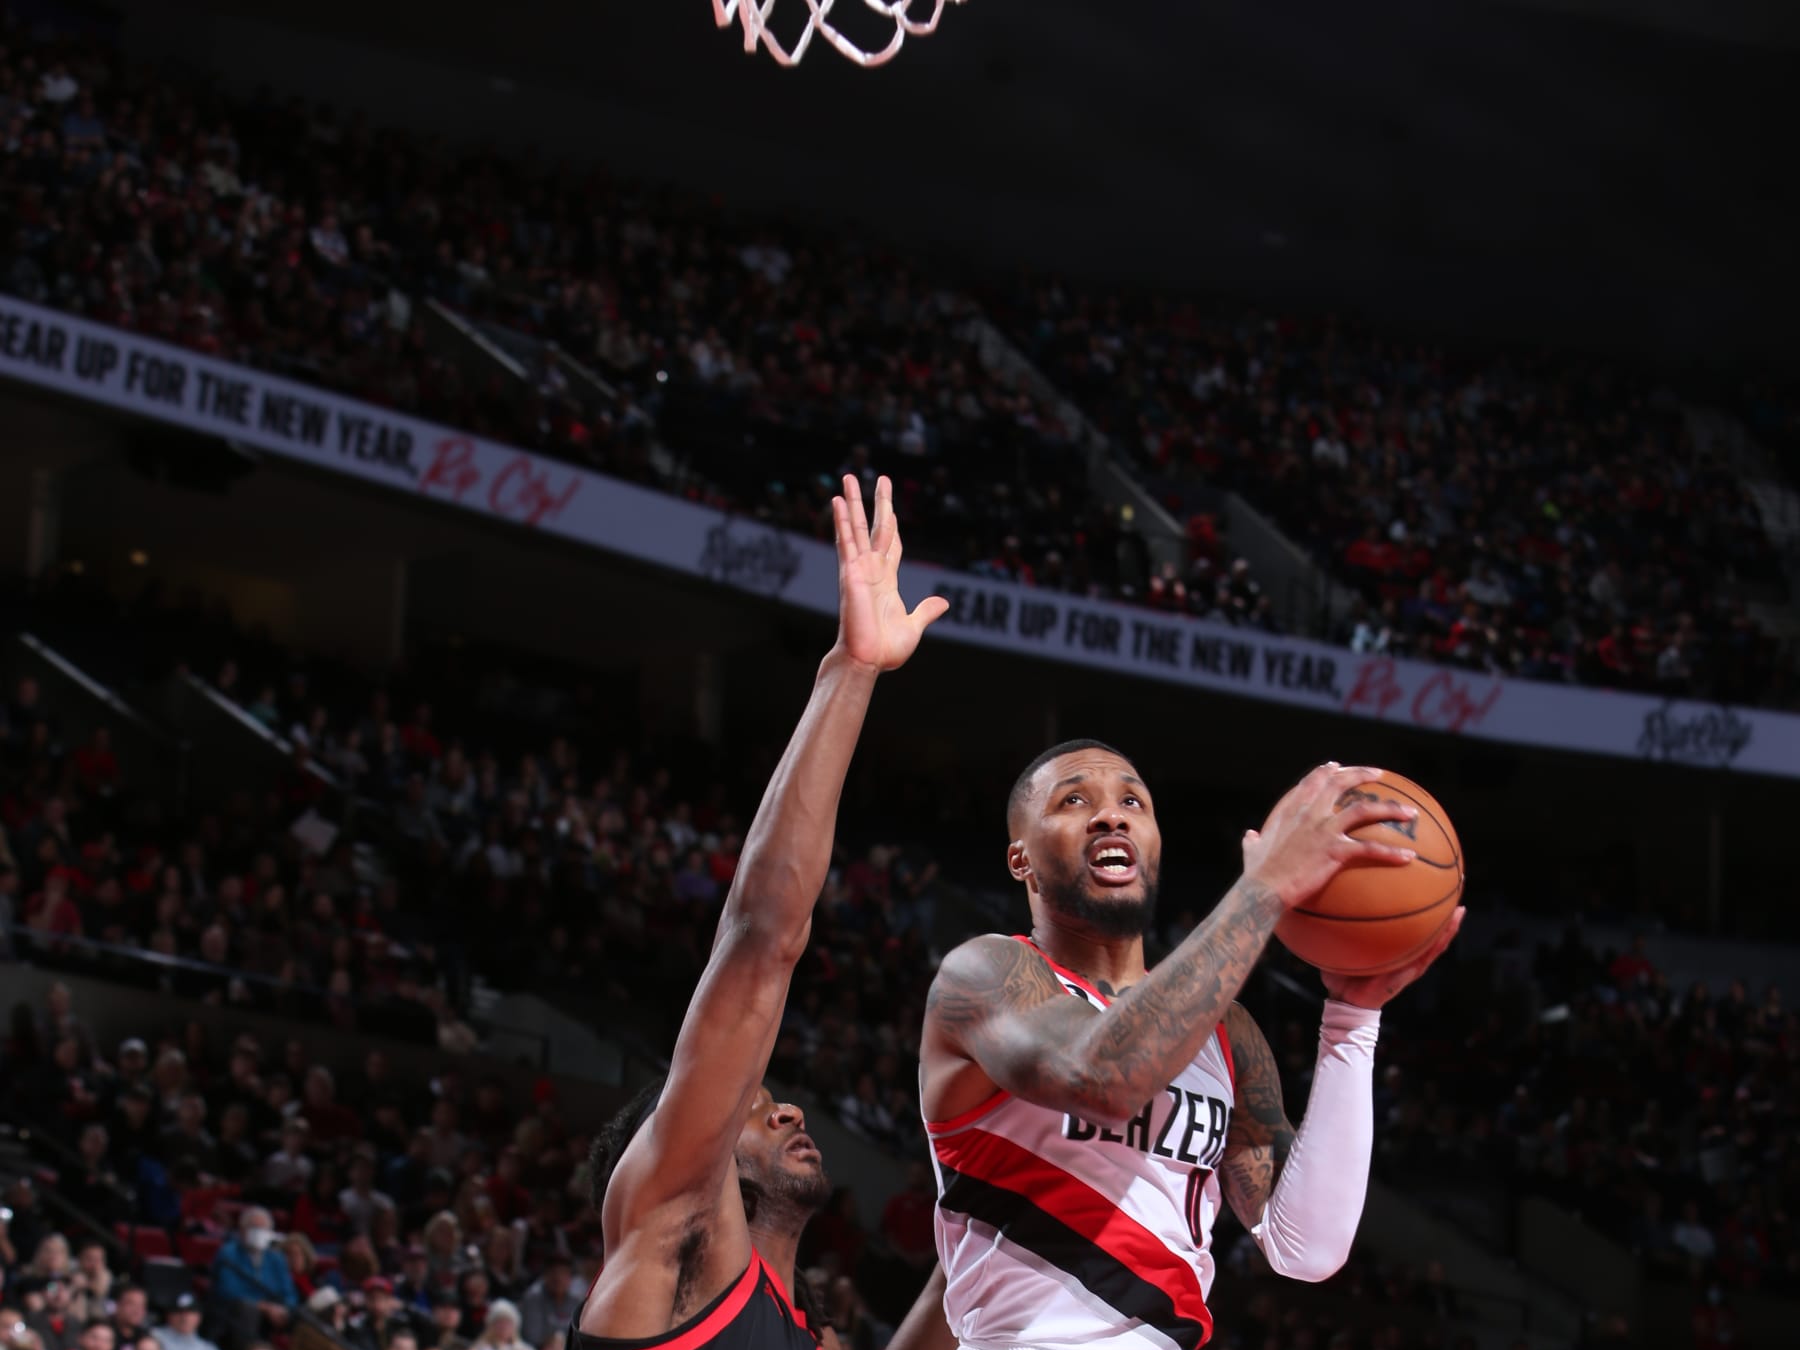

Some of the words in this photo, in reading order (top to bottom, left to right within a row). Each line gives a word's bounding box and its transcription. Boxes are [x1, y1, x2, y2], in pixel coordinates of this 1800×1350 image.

[0, 314, 66, 371] EAR
[74, 335, 118, 384] UP
[125, 350, 187, 405] FOR
[197, 369, 252, 424] THE
[260, 391, 329, 447] NEW
[338, 412, 419, 481] YEAR,
[1016, 603, 1057, 641] UP
[1064, 608, 1122, 655] FOR
[1131, 621, 1183, 667] THE
[1191, 634, 1255, 681] NEW
[1264, 648, 1343, 701] YEAR,
